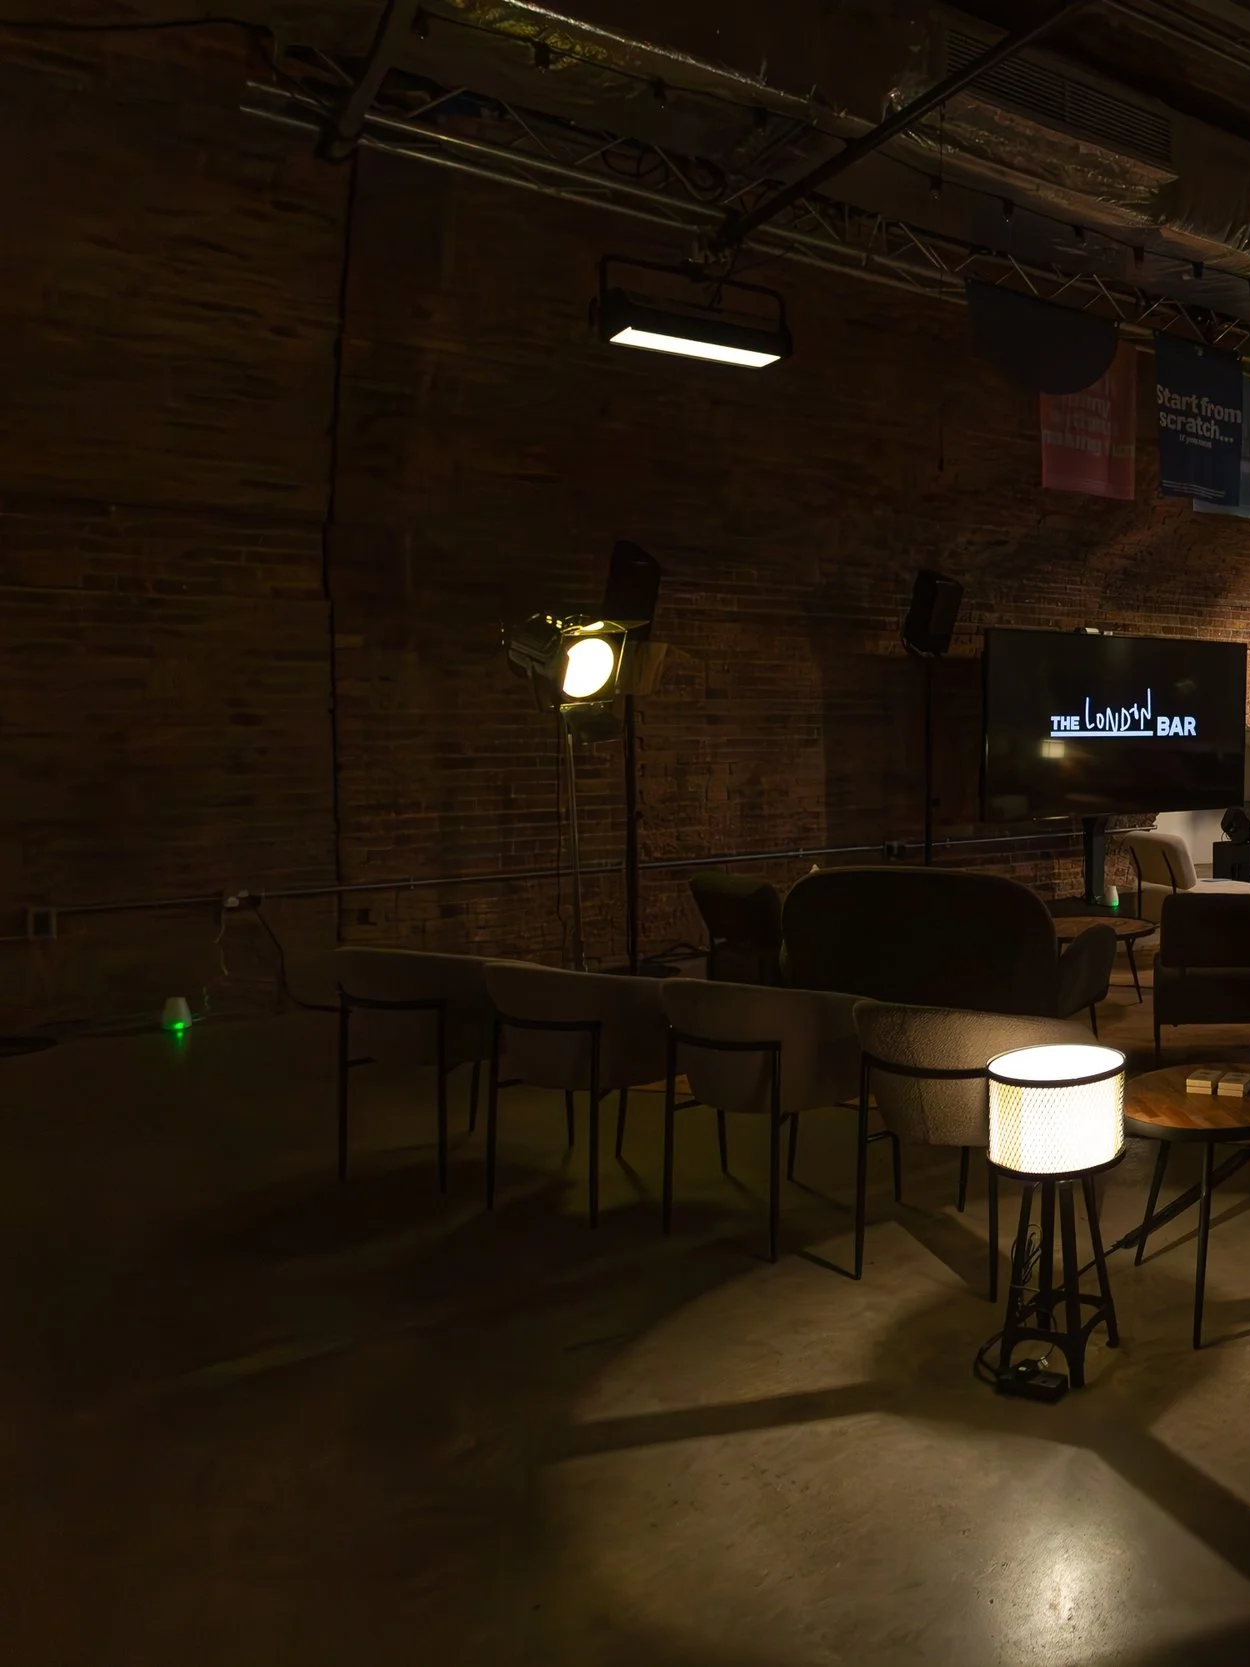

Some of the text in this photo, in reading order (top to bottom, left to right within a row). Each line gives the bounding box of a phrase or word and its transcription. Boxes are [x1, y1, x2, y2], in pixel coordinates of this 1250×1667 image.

[1156, 383, 1243, 424] Start from
[1159, 411, 1235, 444] scratch...
[1050, 715, 1081, 731] THE
[1156, 716, 1197, 737] BAR
